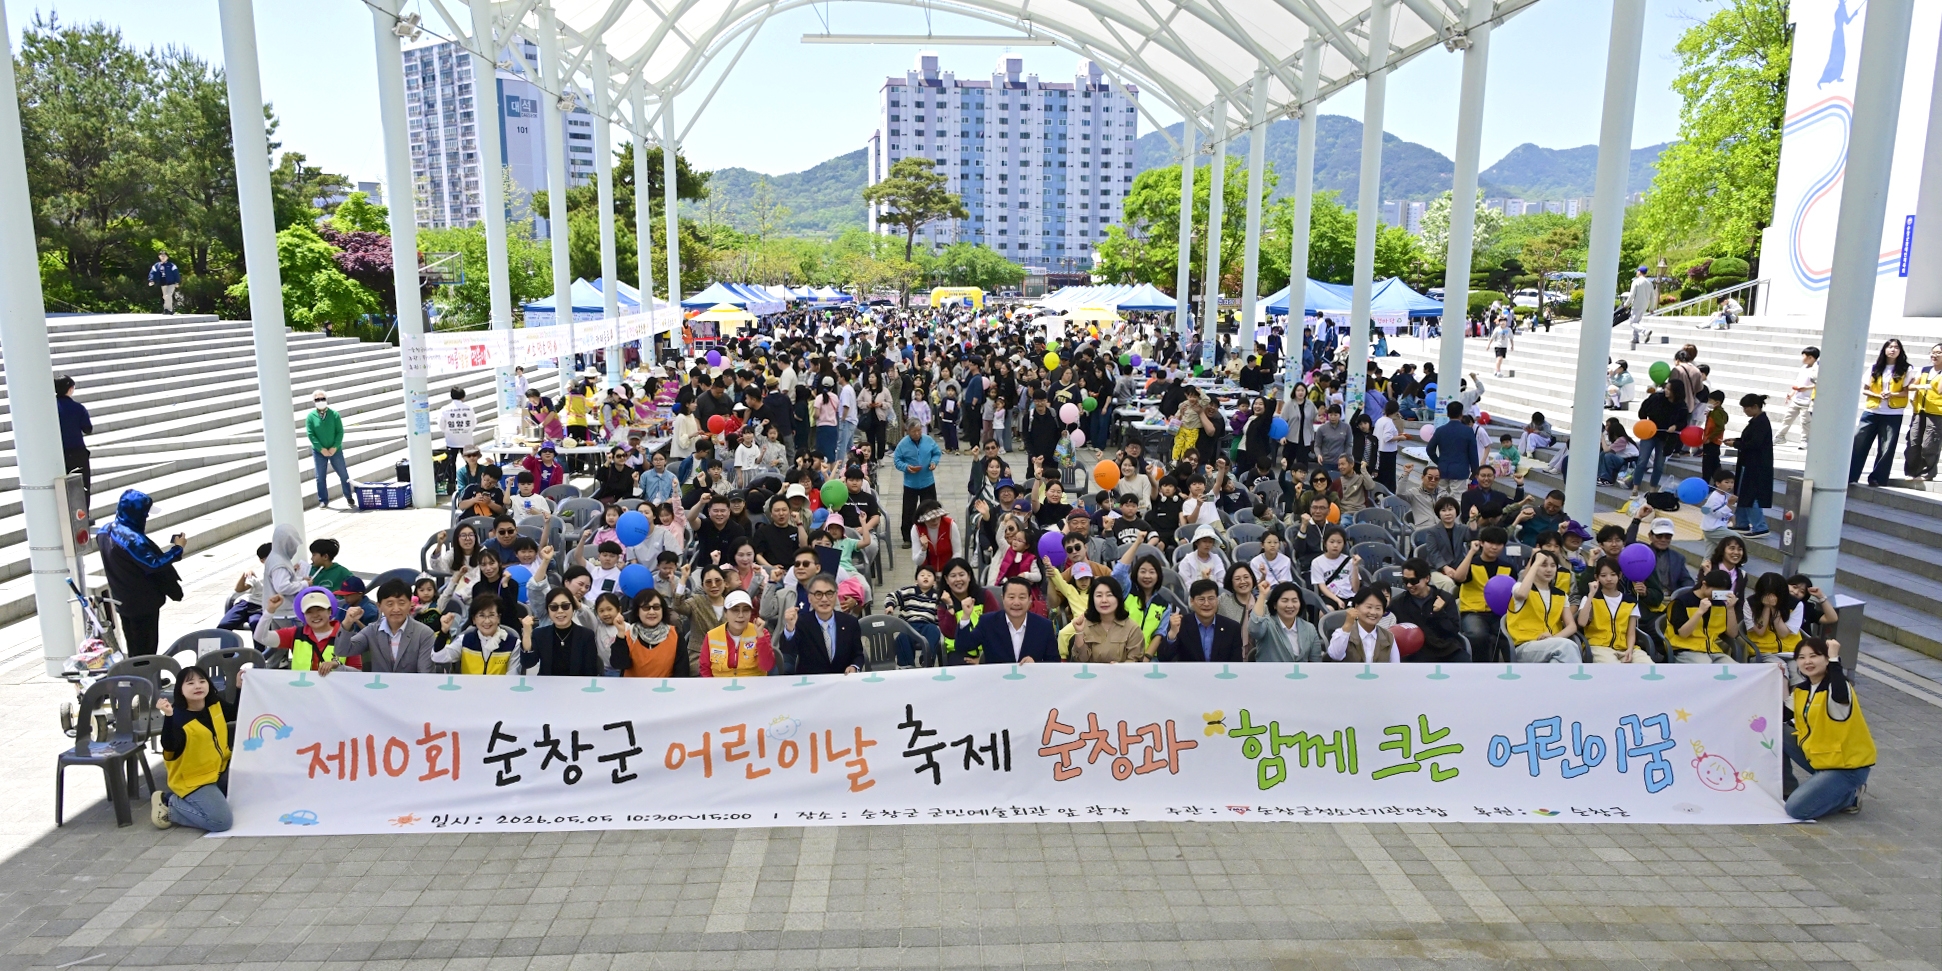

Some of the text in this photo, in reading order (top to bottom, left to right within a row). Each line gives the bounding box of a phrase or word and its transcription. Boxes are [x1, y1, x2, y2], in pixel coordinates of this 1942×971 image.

[517, 126, 528, 134] 101
[296, 722, 461, 782] 제10회
[483, 720, 644, 787] 순창군
[664, 722, 878, 793] 어린이날
[898, 704, 1011, 785] 축제
[1037, 708, 1199, 782] 순창과
[1228, 708, 1358, 791] 함께
[1371, 713, 1464, 782] 크는
[496, 814, 613, 825] 2026.05.05
[861, 808, 919, 820] 순창군
[927, 805, 1050, 819] 군민예술회관
[1057, 807, 1080, 818] 앞
[1085, 805, 1131, 816] 광장
[1570, 806, 1632, 818] 순창군
